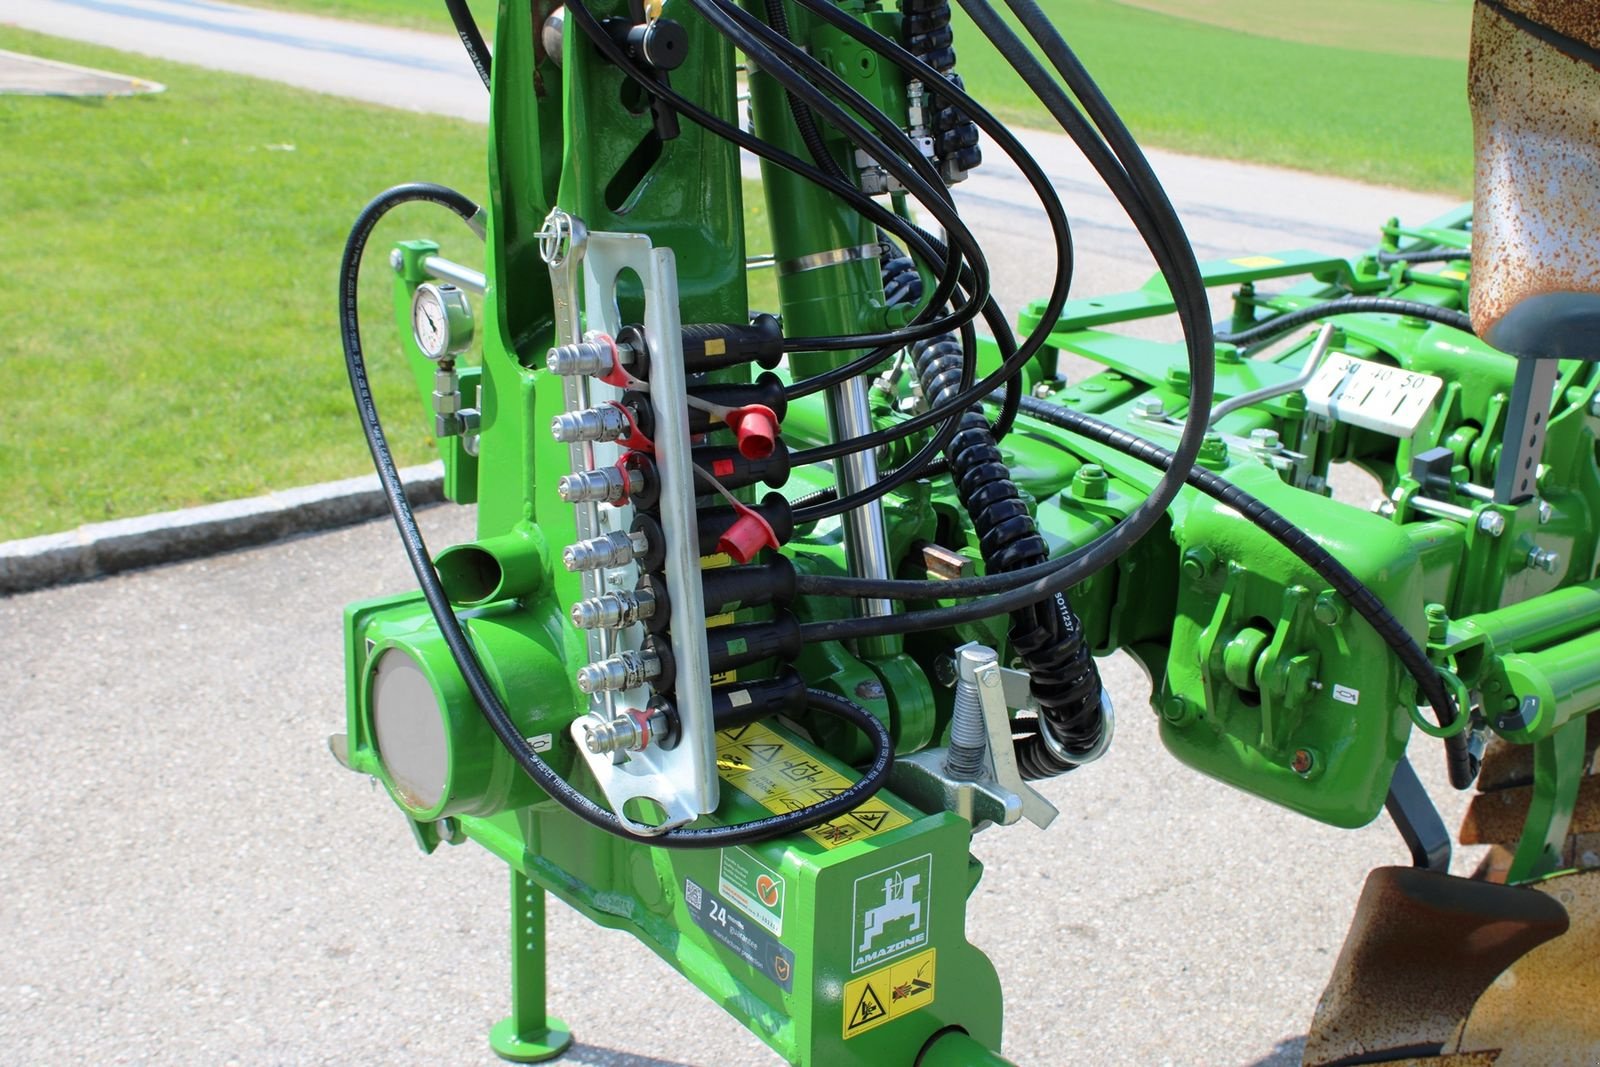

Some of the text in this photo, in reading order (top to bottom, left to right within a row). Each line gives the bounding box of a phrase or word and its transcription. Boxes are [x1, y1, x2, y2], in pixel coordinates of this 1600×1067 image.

[1339, 360, 1361, 374] 30
[1401, 374, 1425, 388] 50
[709, 899, 727, 928] 24
[855, 932, 925, 968] AMAZONE
